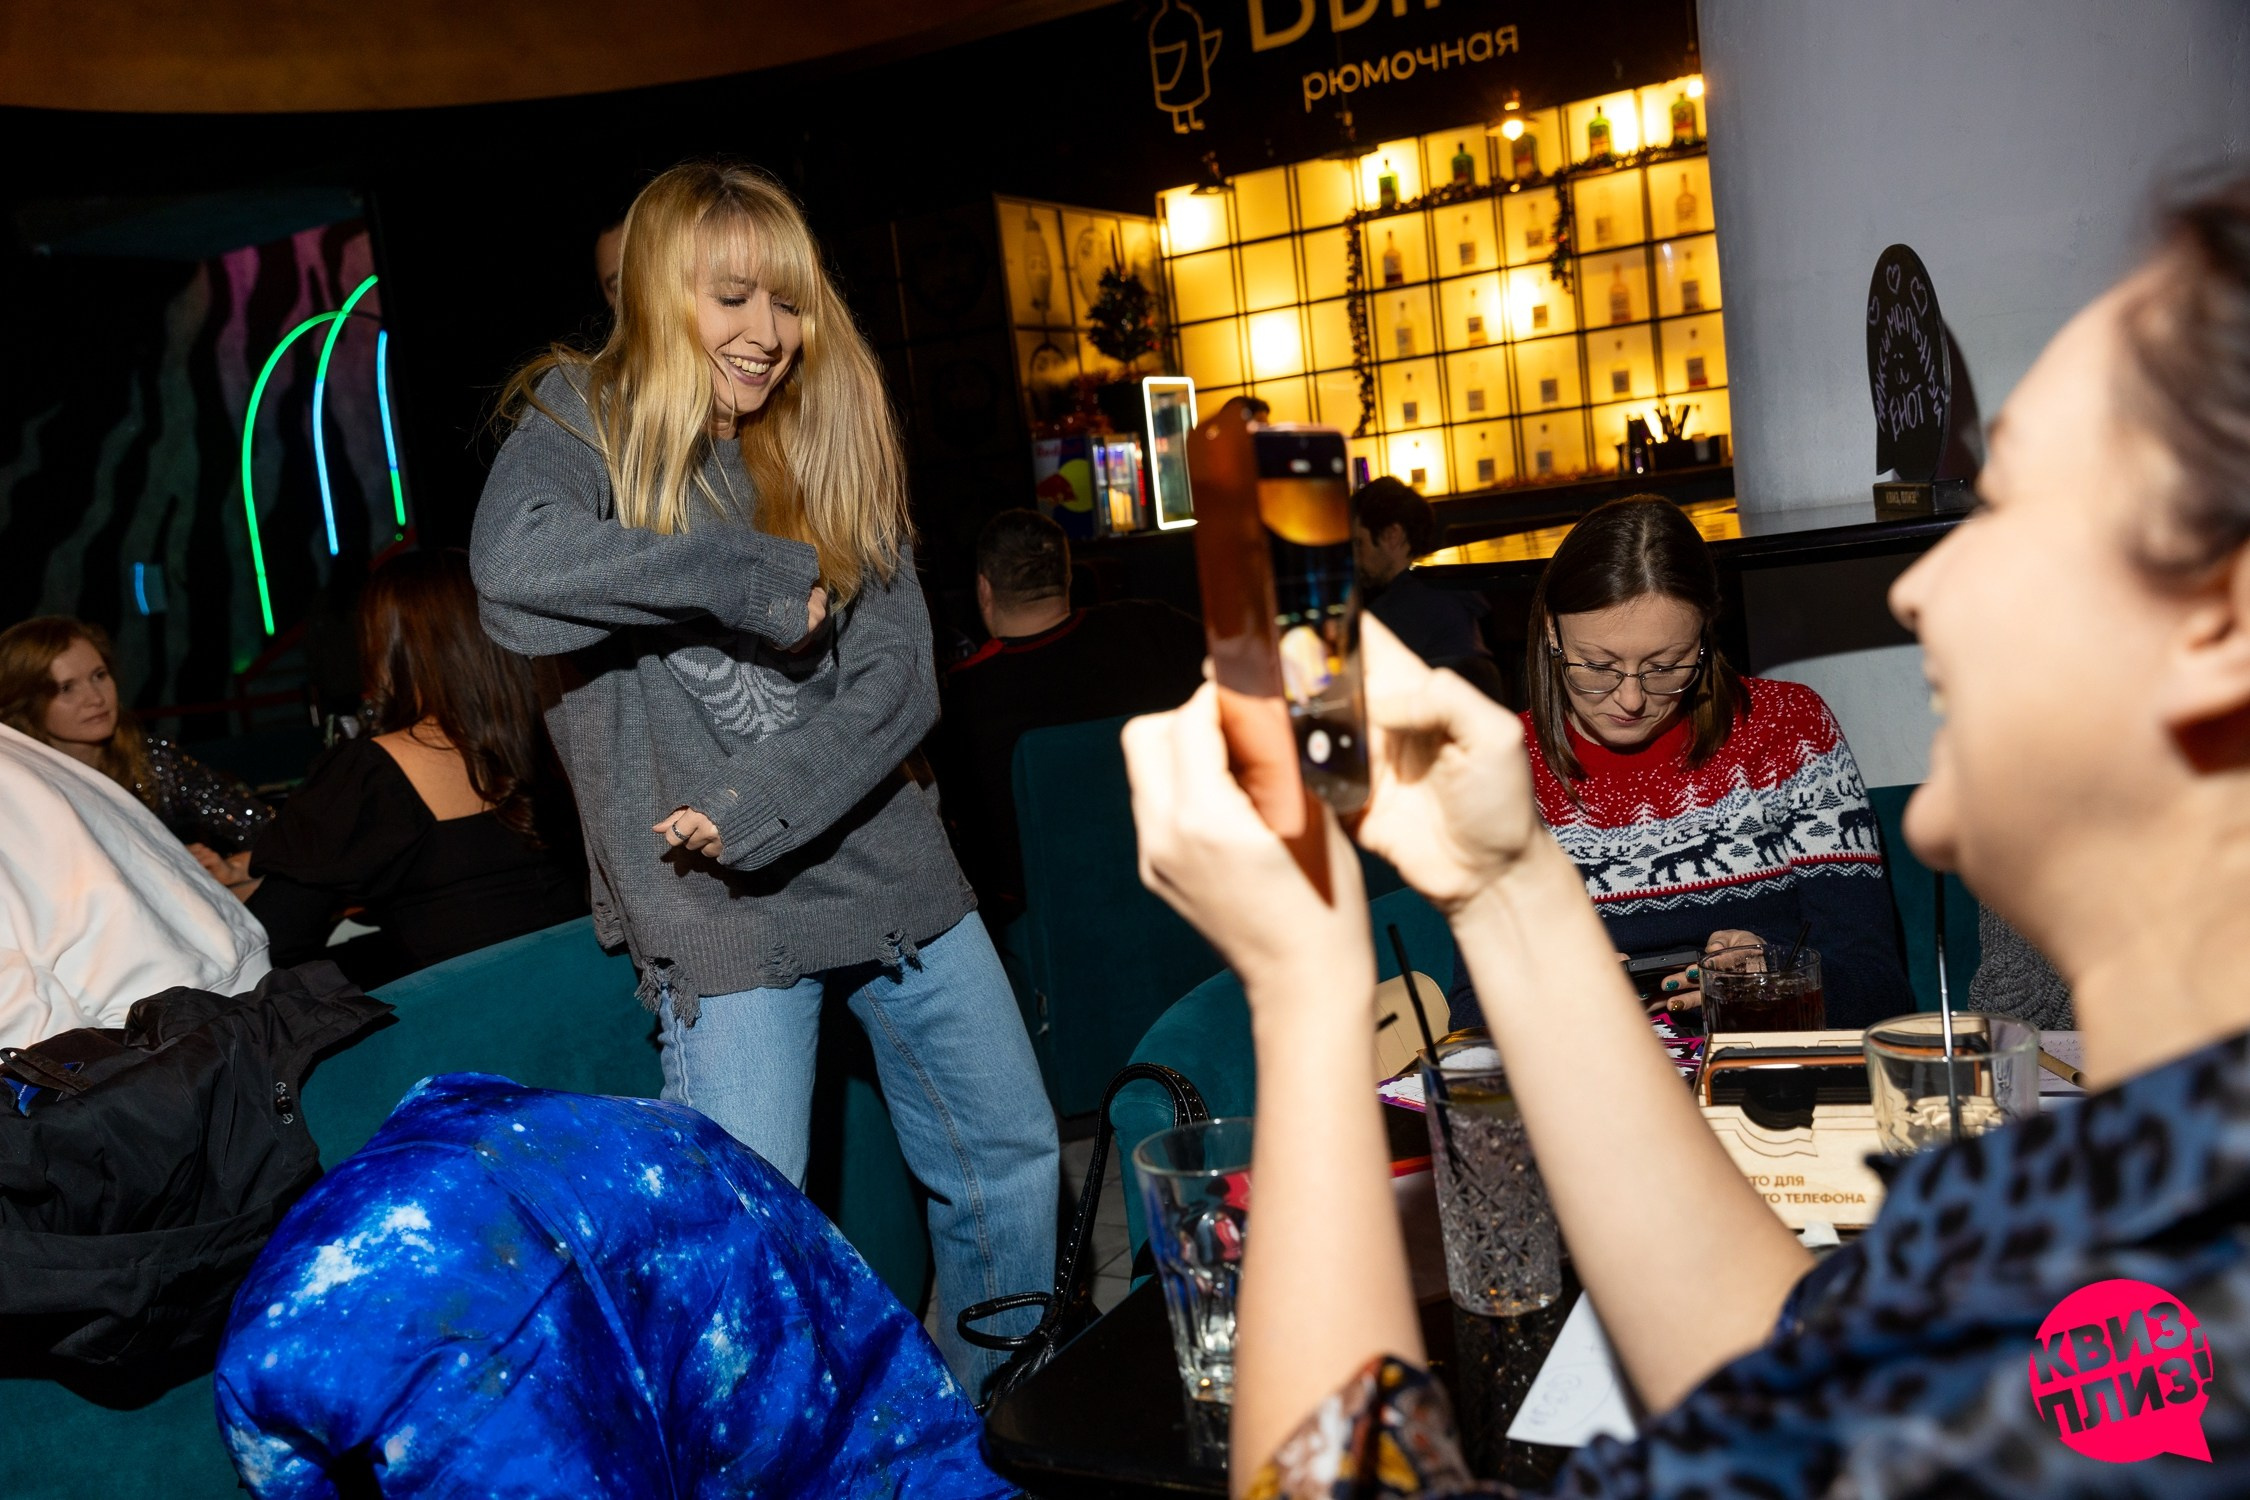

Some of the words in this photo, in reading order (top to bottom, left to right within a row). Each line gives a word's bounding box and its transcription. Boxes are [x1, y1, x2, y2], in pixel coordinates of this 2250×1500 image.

[1302, 24, 1519, 113] рюмочная
[1888, 383, 1924, 442] ЕНОТ
[1749, 1175, 1770, 1187] ТО
[1774, 1175, 1805, 1187] ДЛЯ
[1762, 1192, 1781, 1204] ГО
[1784, 1192, 1866, 1204] ТЕЛЕФОНА
